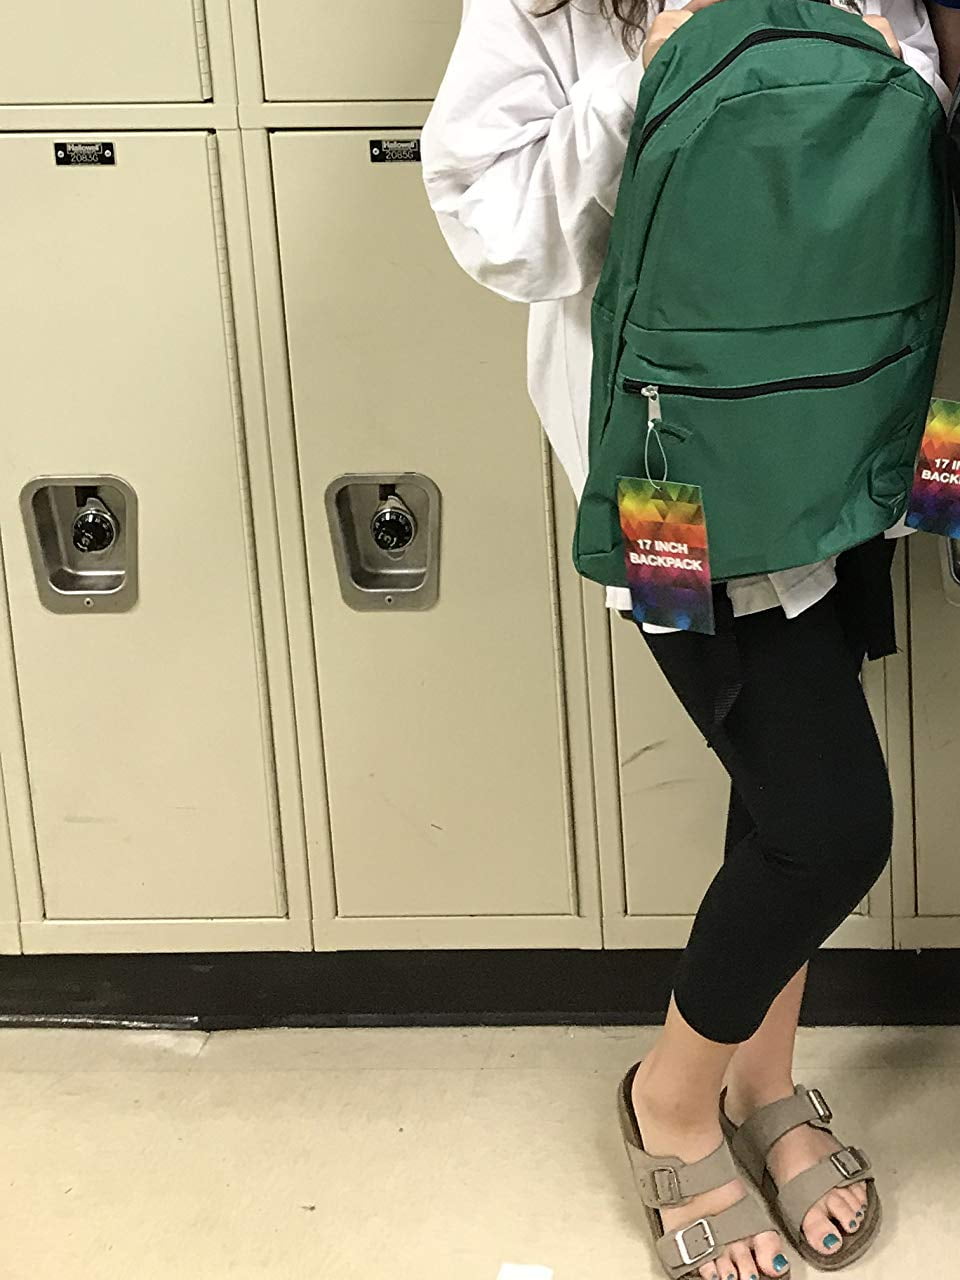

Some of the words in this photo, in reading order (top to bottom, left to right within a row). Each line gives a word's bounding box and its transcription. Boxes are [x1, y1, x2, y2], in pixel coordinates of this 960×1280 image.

[935, 458, 950, 469] 17
[637, 538, 652, 551] 17
[654, 540, 689, 554] INCH
[629, 552, 703, 571] BACKPACK
